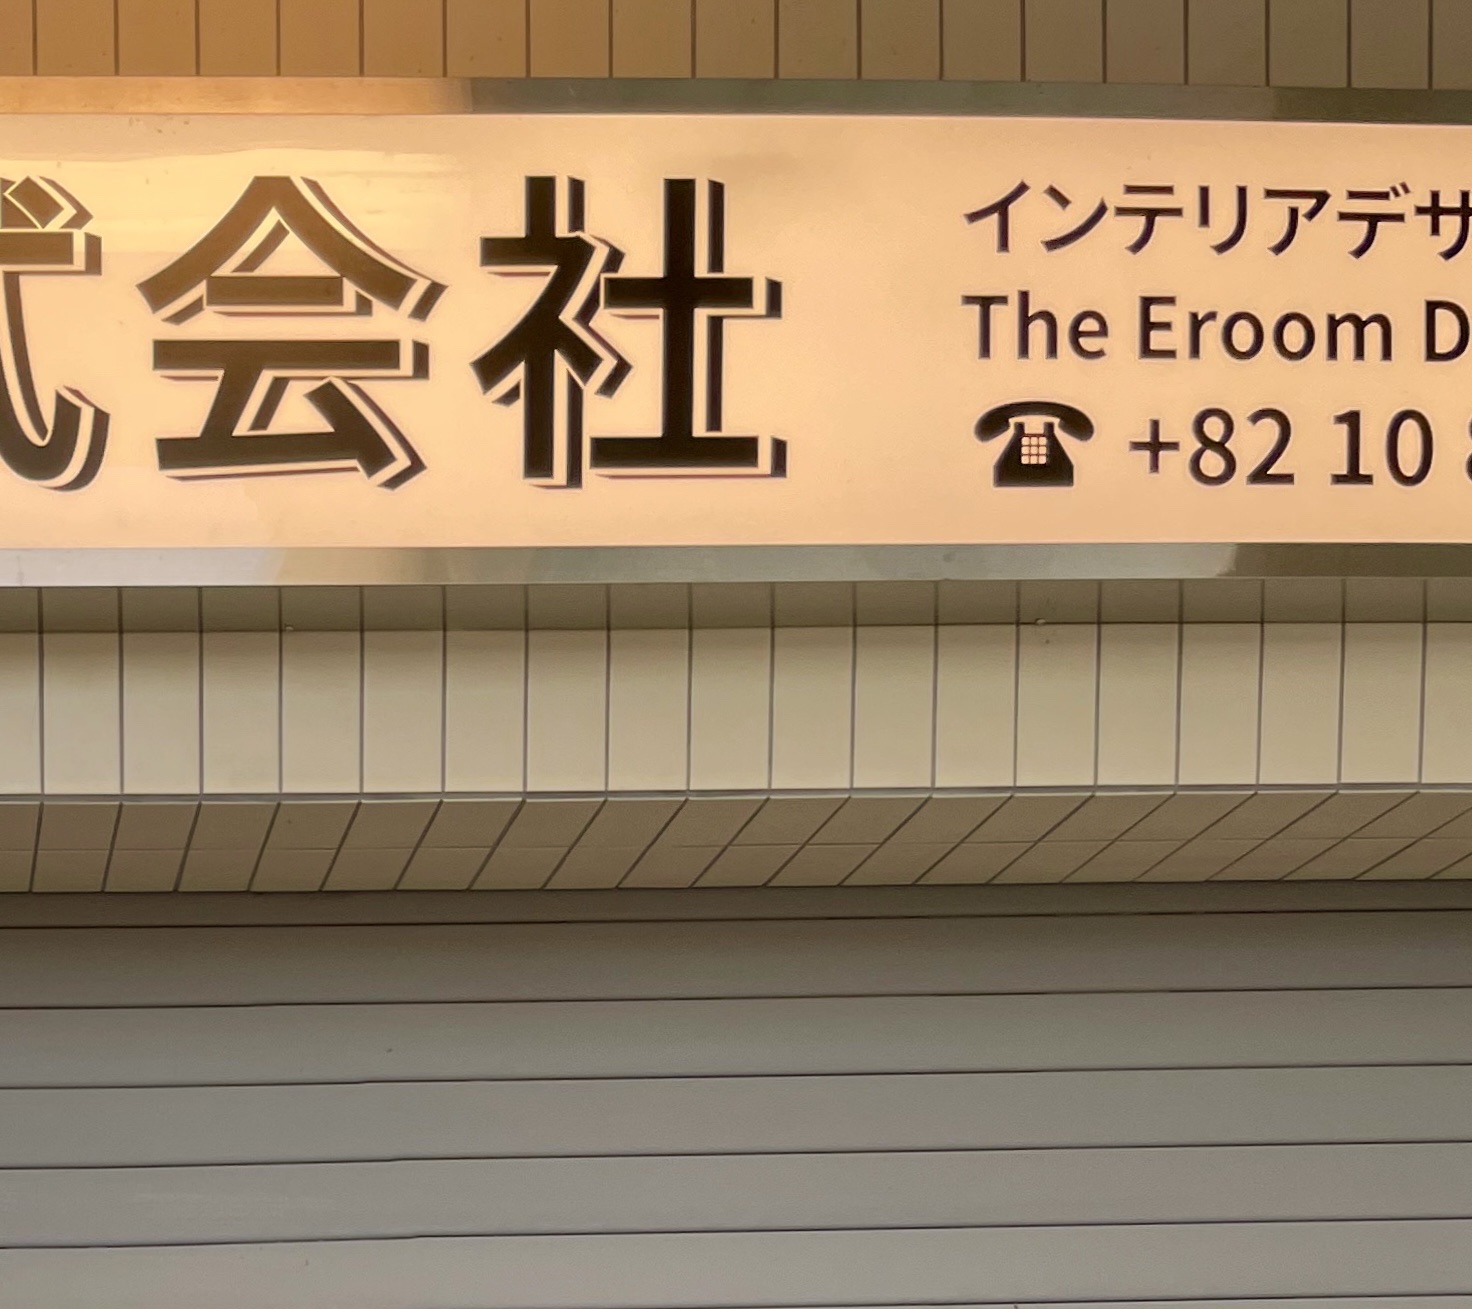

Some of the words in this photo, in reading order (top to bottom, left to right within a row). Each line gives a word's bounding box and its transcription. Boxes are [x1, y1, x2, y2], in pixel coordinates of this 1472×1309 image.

[963, 180, 1472, 260] インテリアデサ
[961, 290, 1109, 360] The
[1138, 296, 1392, 362] Eroom
[1129, 408, 1295, 488] +82
[1330, 408, 1434, 487] 10
